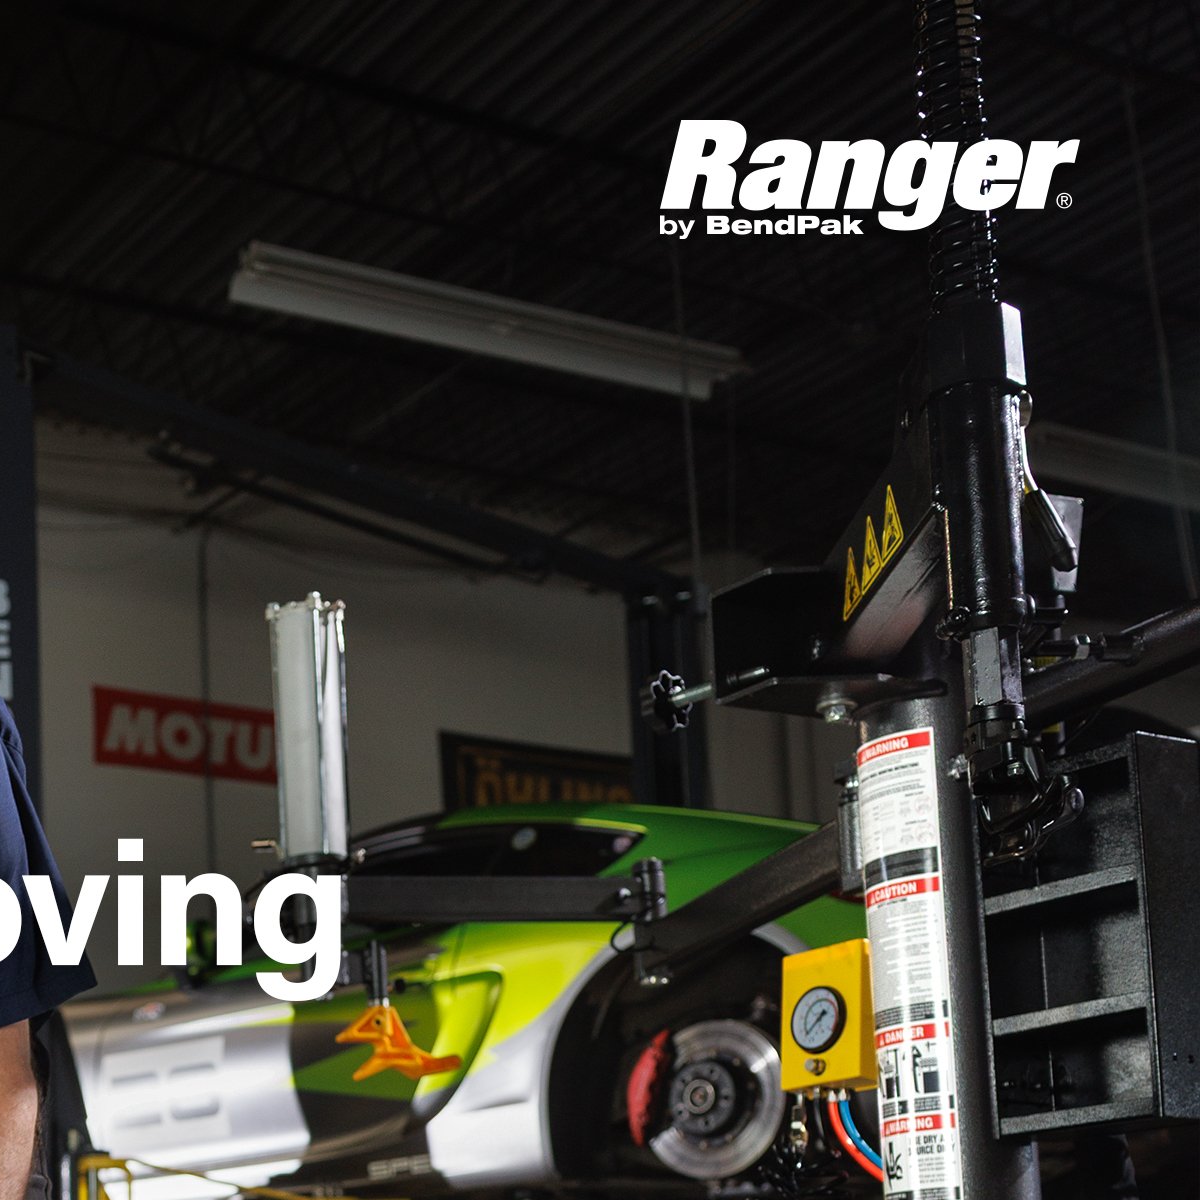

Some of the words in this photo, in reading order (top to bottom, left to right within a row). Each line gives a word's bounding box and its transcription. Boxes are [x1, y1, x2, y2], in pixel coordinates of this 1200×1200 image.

[866, 737, 909, 760] WARNING
[875, 881, 917, 903] CAUTION
[885, 1027, 924, 1043] DANER
[889, 1116, 933, 1132] WARNG
